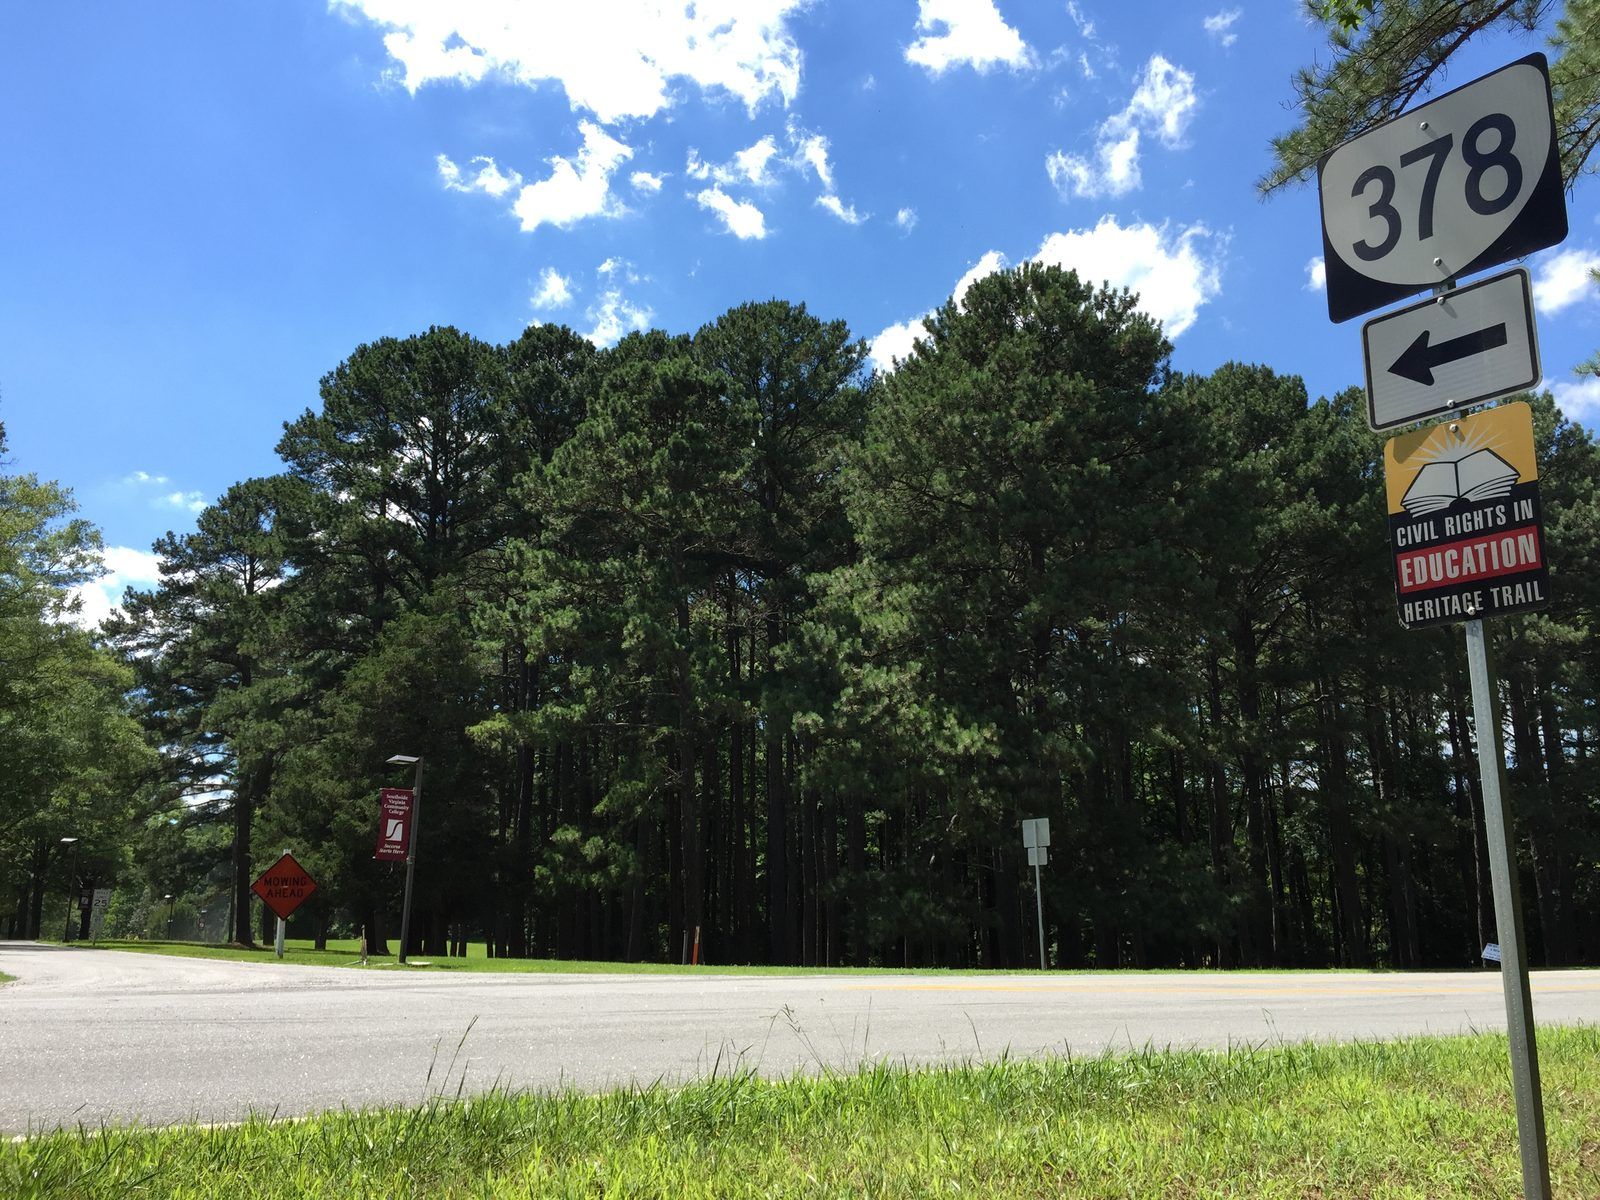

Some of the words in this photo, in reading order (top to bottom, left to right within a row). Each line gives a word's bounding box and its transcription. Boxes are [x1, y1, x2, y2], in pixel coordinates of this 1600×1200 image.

[1351, 112, 1523, 262] 378
[1396, 520, 1438, 547] CIVIL
[1444, 504, 1506, 537] RIGHTS
[1513, 499, 1533, 522] IN
[1400, 533, 1537, 588] EDUCATION
[1404, 590, 1484, 623] HERITAGE
[1490, 580, 1544, 609] TRAIL
[94, 899, 107, 907] 25
[264, 876, 306, 887] MOWING
[267, 888, 304, 898] AHEAD
